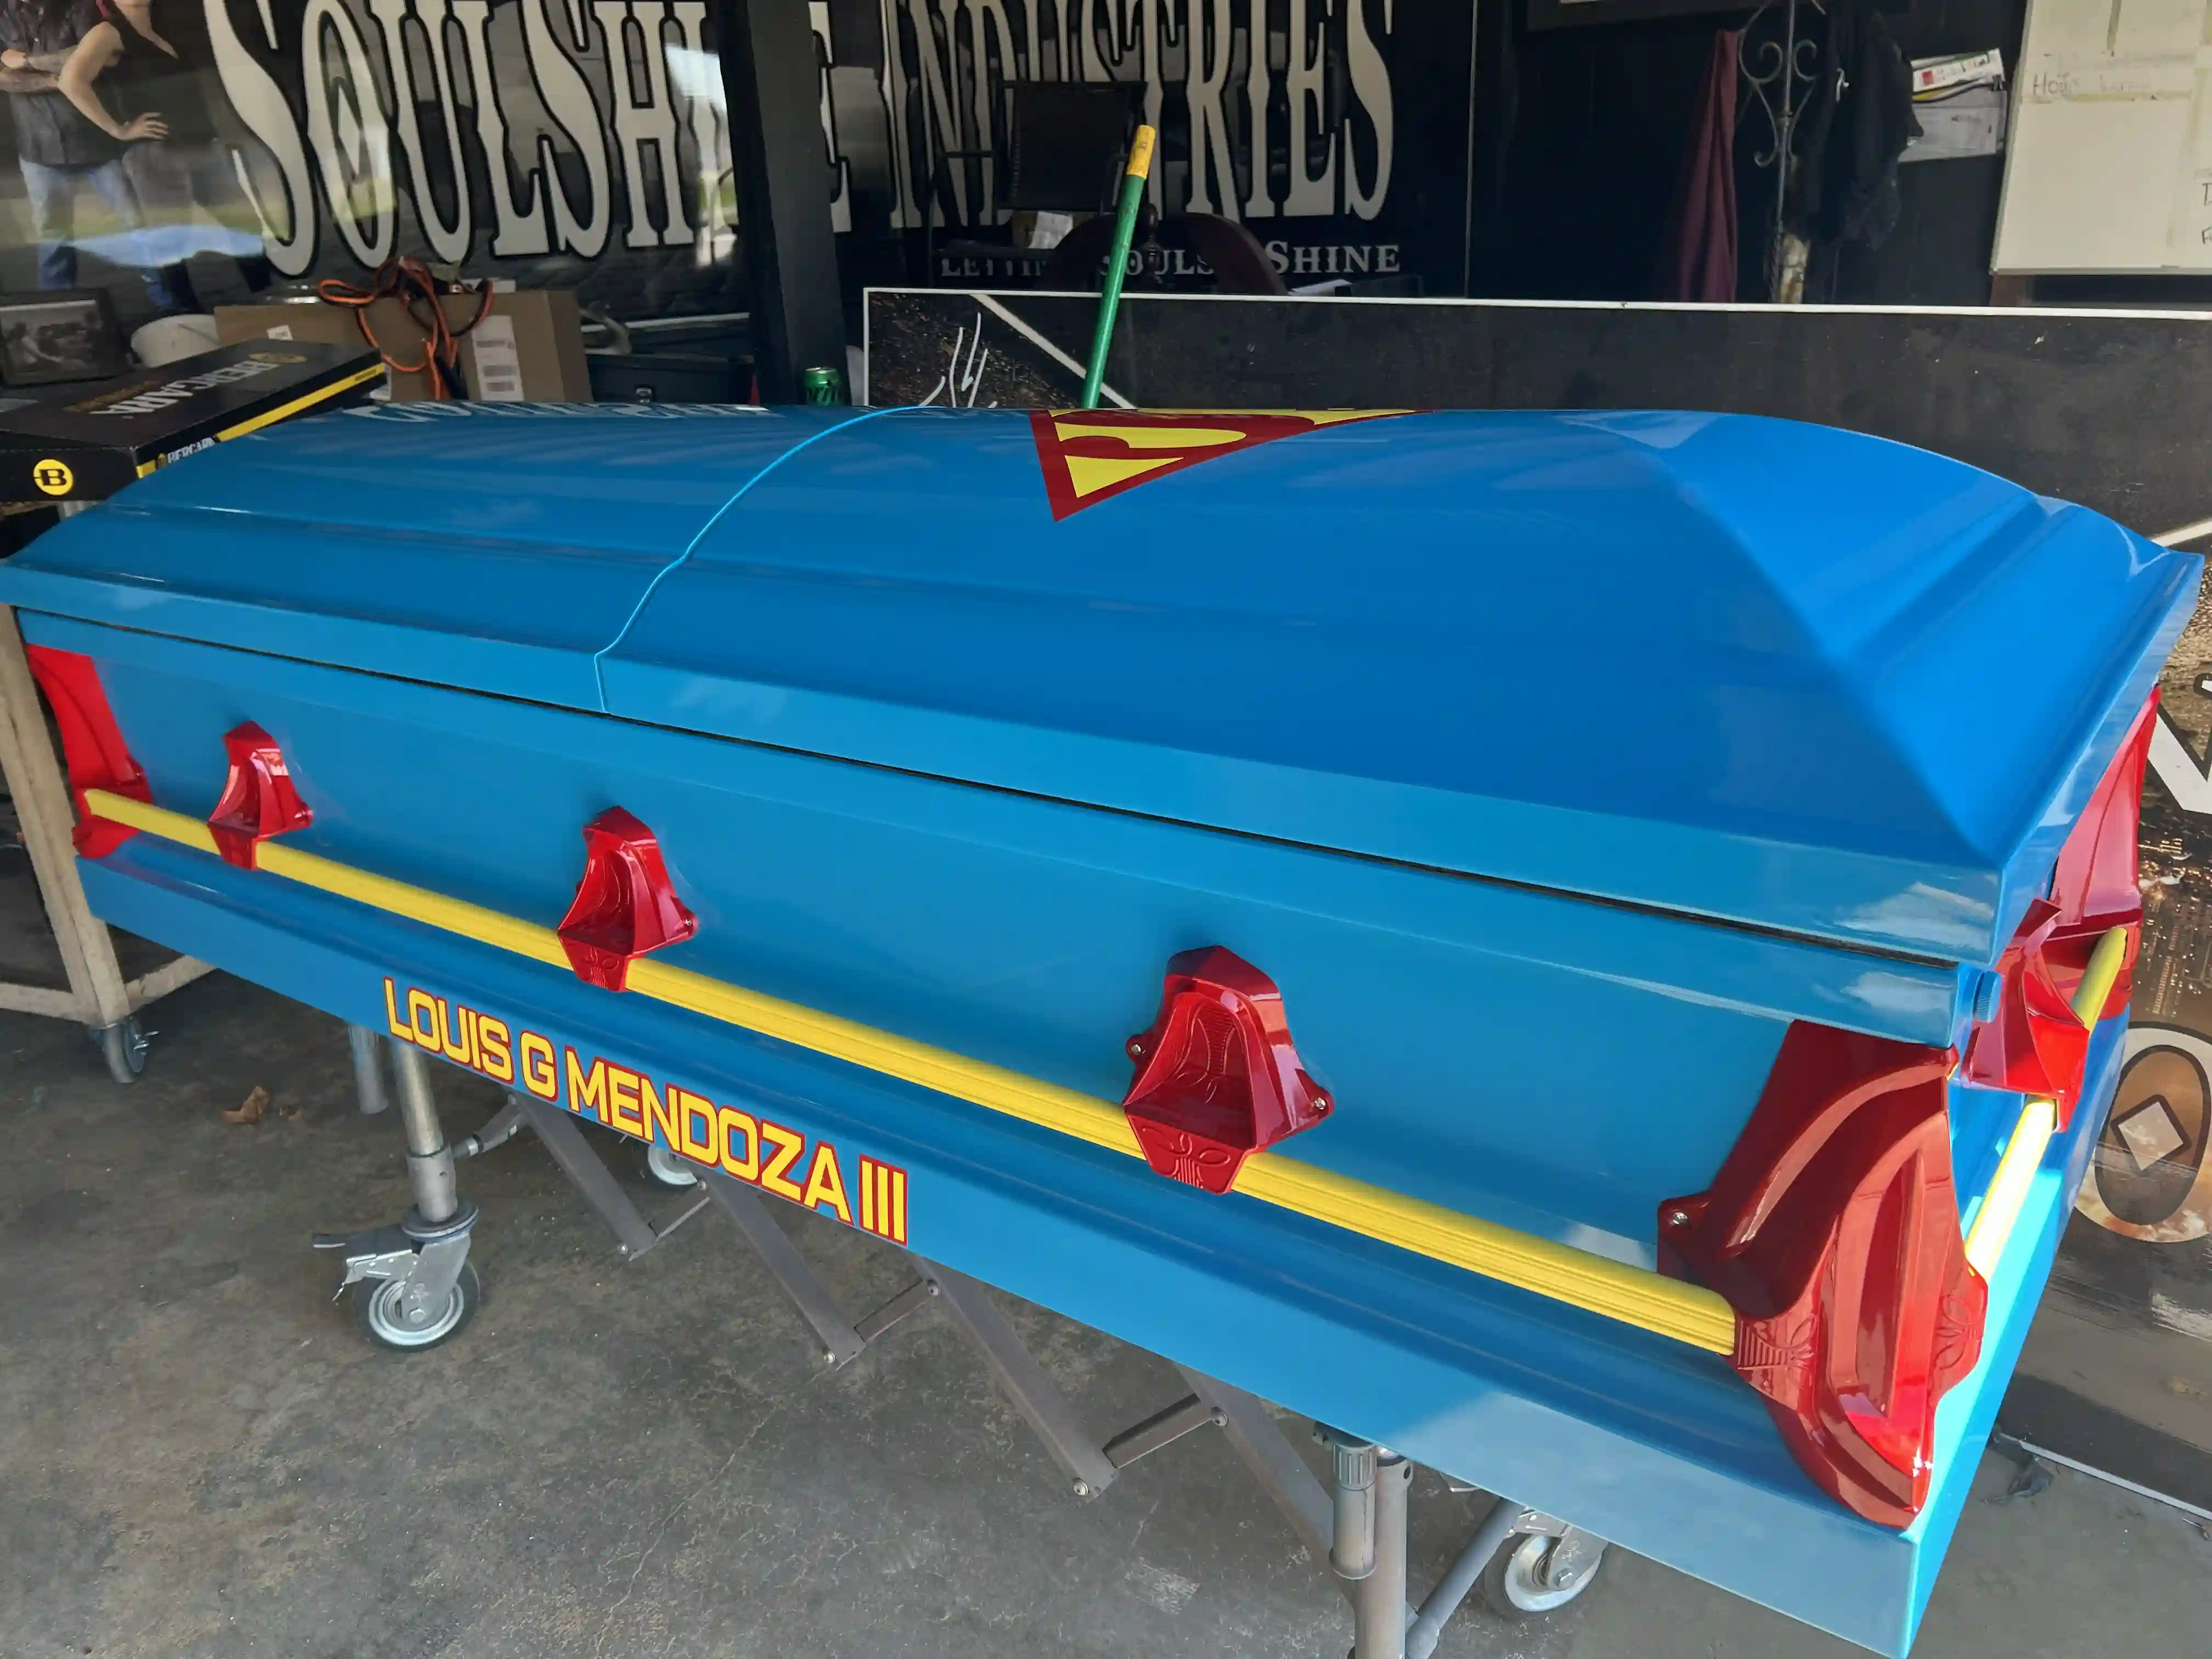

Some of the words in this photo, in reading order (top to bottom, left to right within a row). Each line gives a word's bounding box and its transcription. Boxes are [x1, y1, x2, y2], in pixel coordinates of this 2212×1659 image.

[204, 0, 854, 276] SOULSHI
[878, 0, 1392, 228] INDTRIES
[1264, 240, 1400, 274] SHINE
[383, 977, 514, 1085] LOUIS
[520, 1029, 559, 1102] G
[564, 1044, 855, 1228] MENDOZA
[859, 1154, 909, 1247] III
